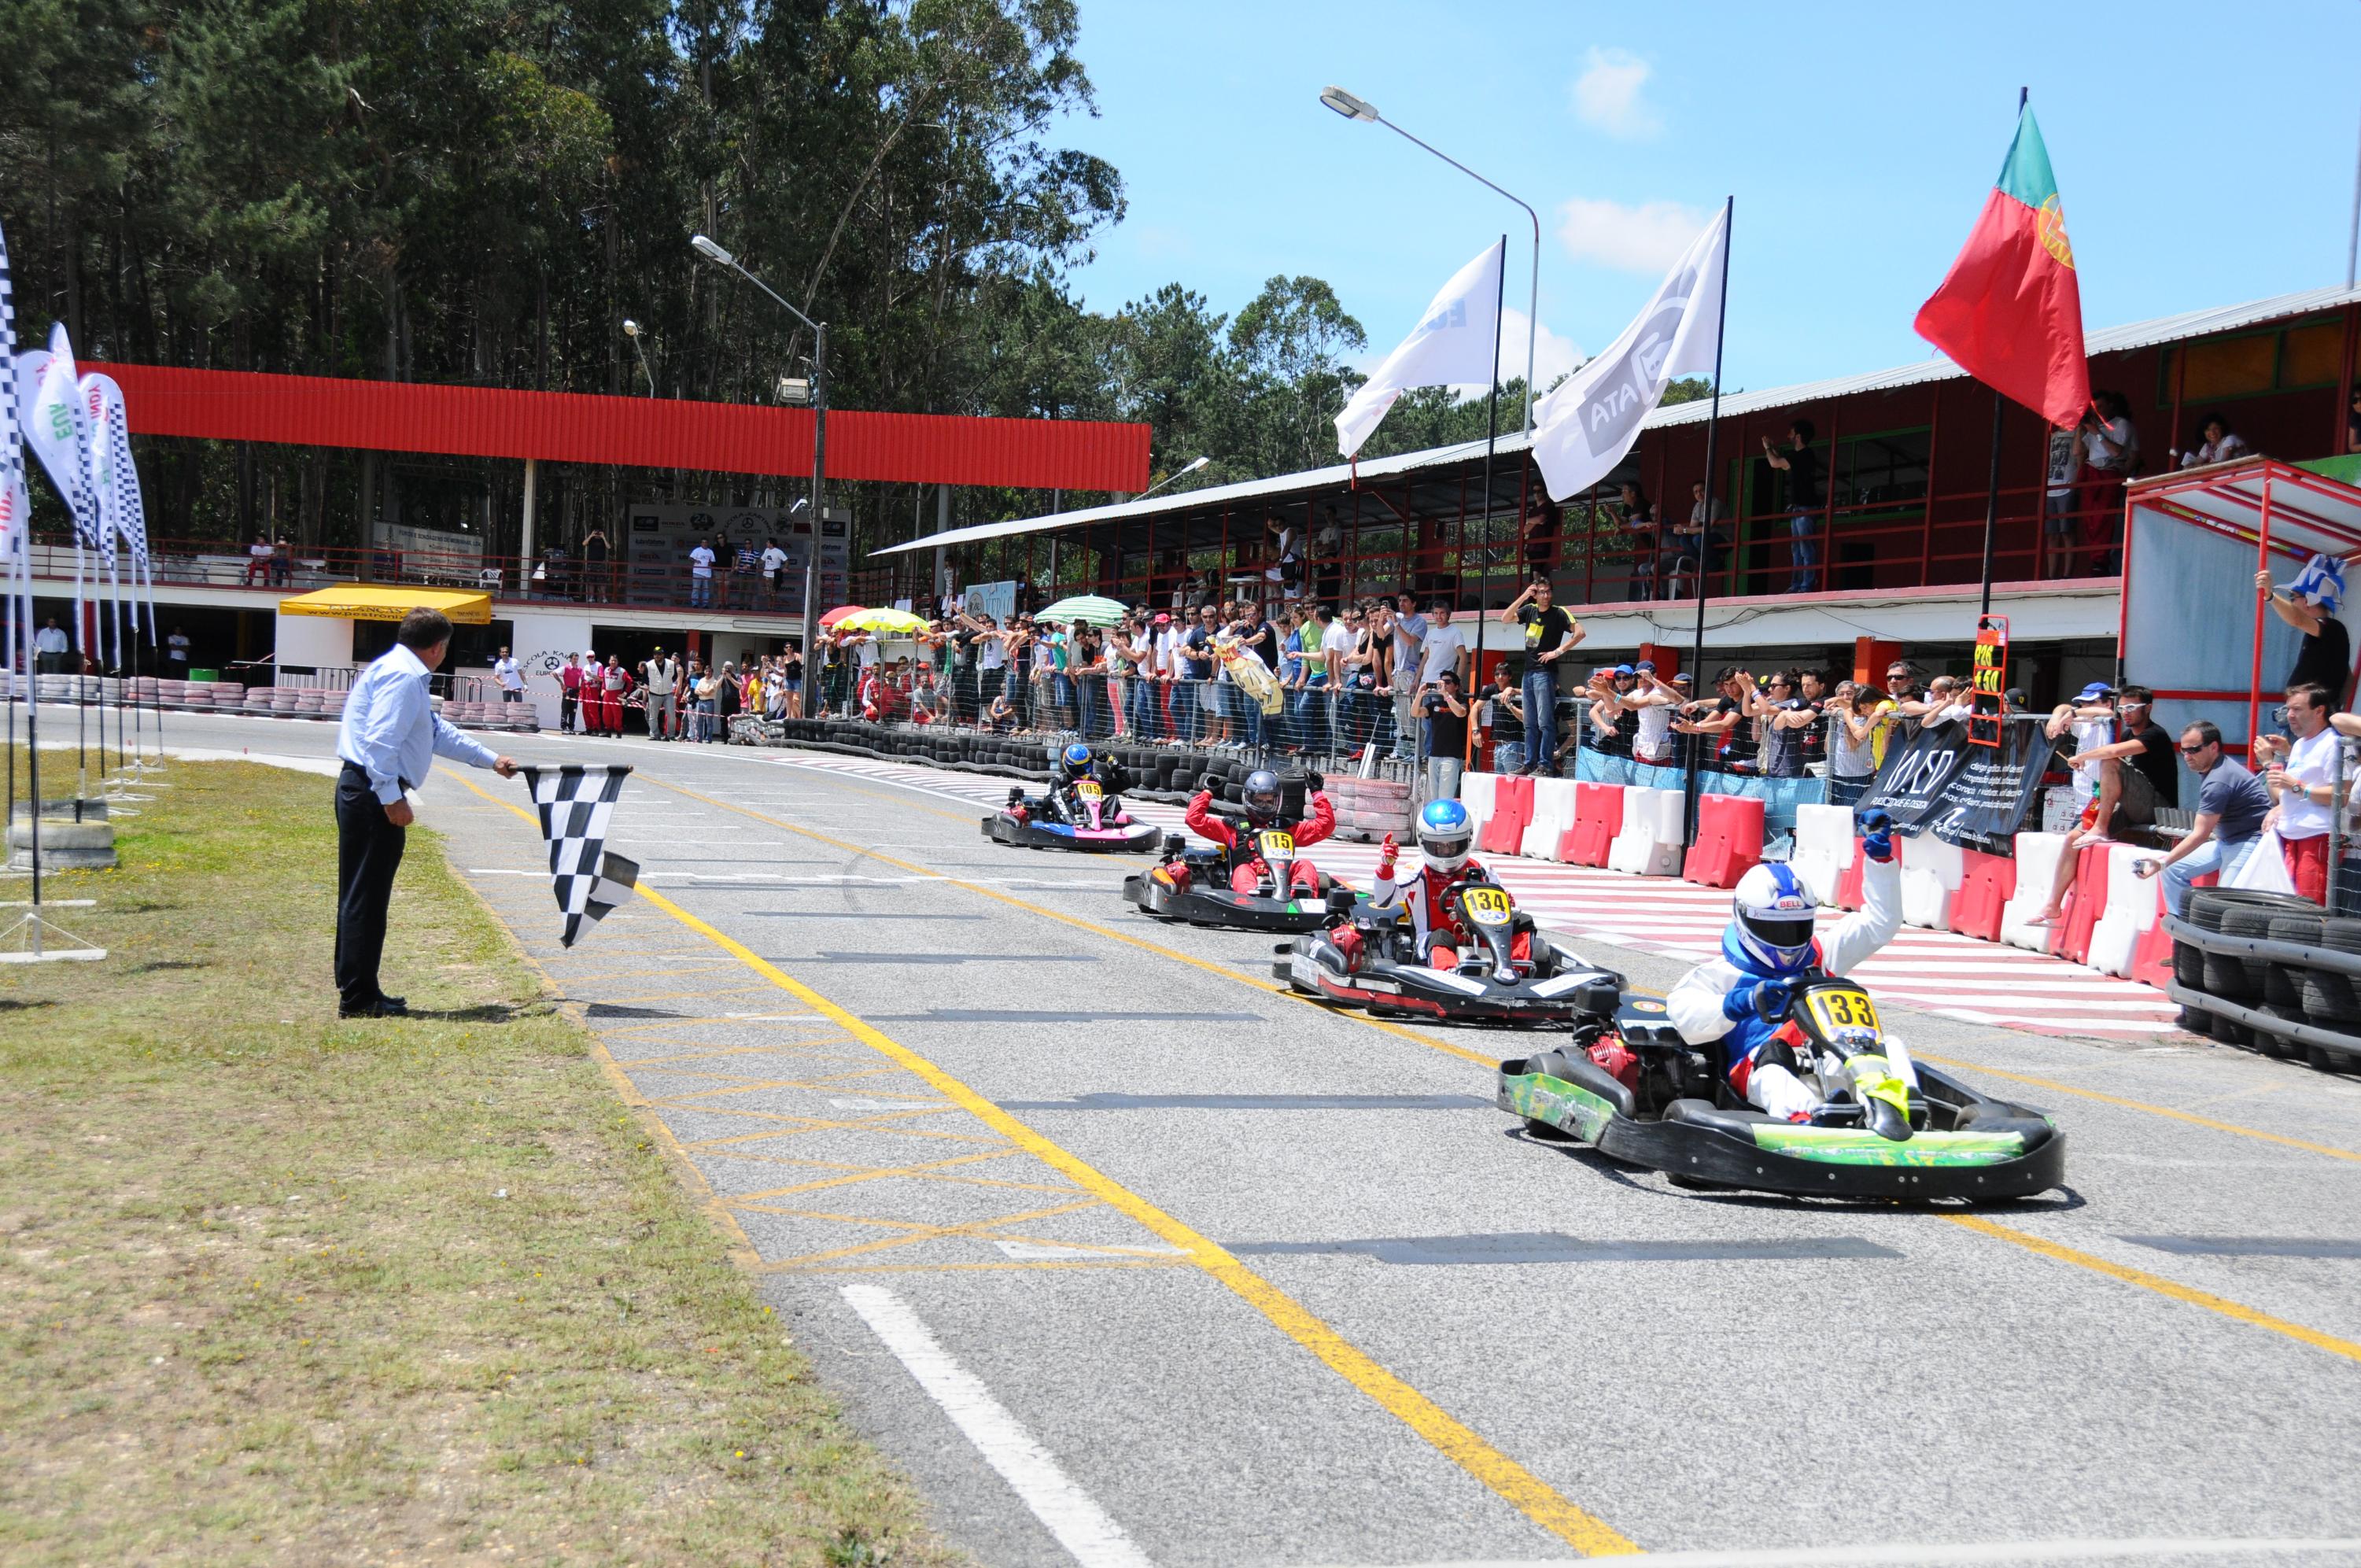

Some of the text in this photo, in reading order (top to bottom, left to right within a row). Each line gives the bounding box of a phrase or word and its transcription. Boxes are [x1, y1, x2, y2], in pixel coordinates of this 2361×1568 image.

[1974, 644, 1994, 667] P26
[1080, 784, 1100, 795] 105
[1264, 834, 1290, 849] 115
[1466, 891, 1506, 913] 134
[1815, 994, 1875, 1028] 133
